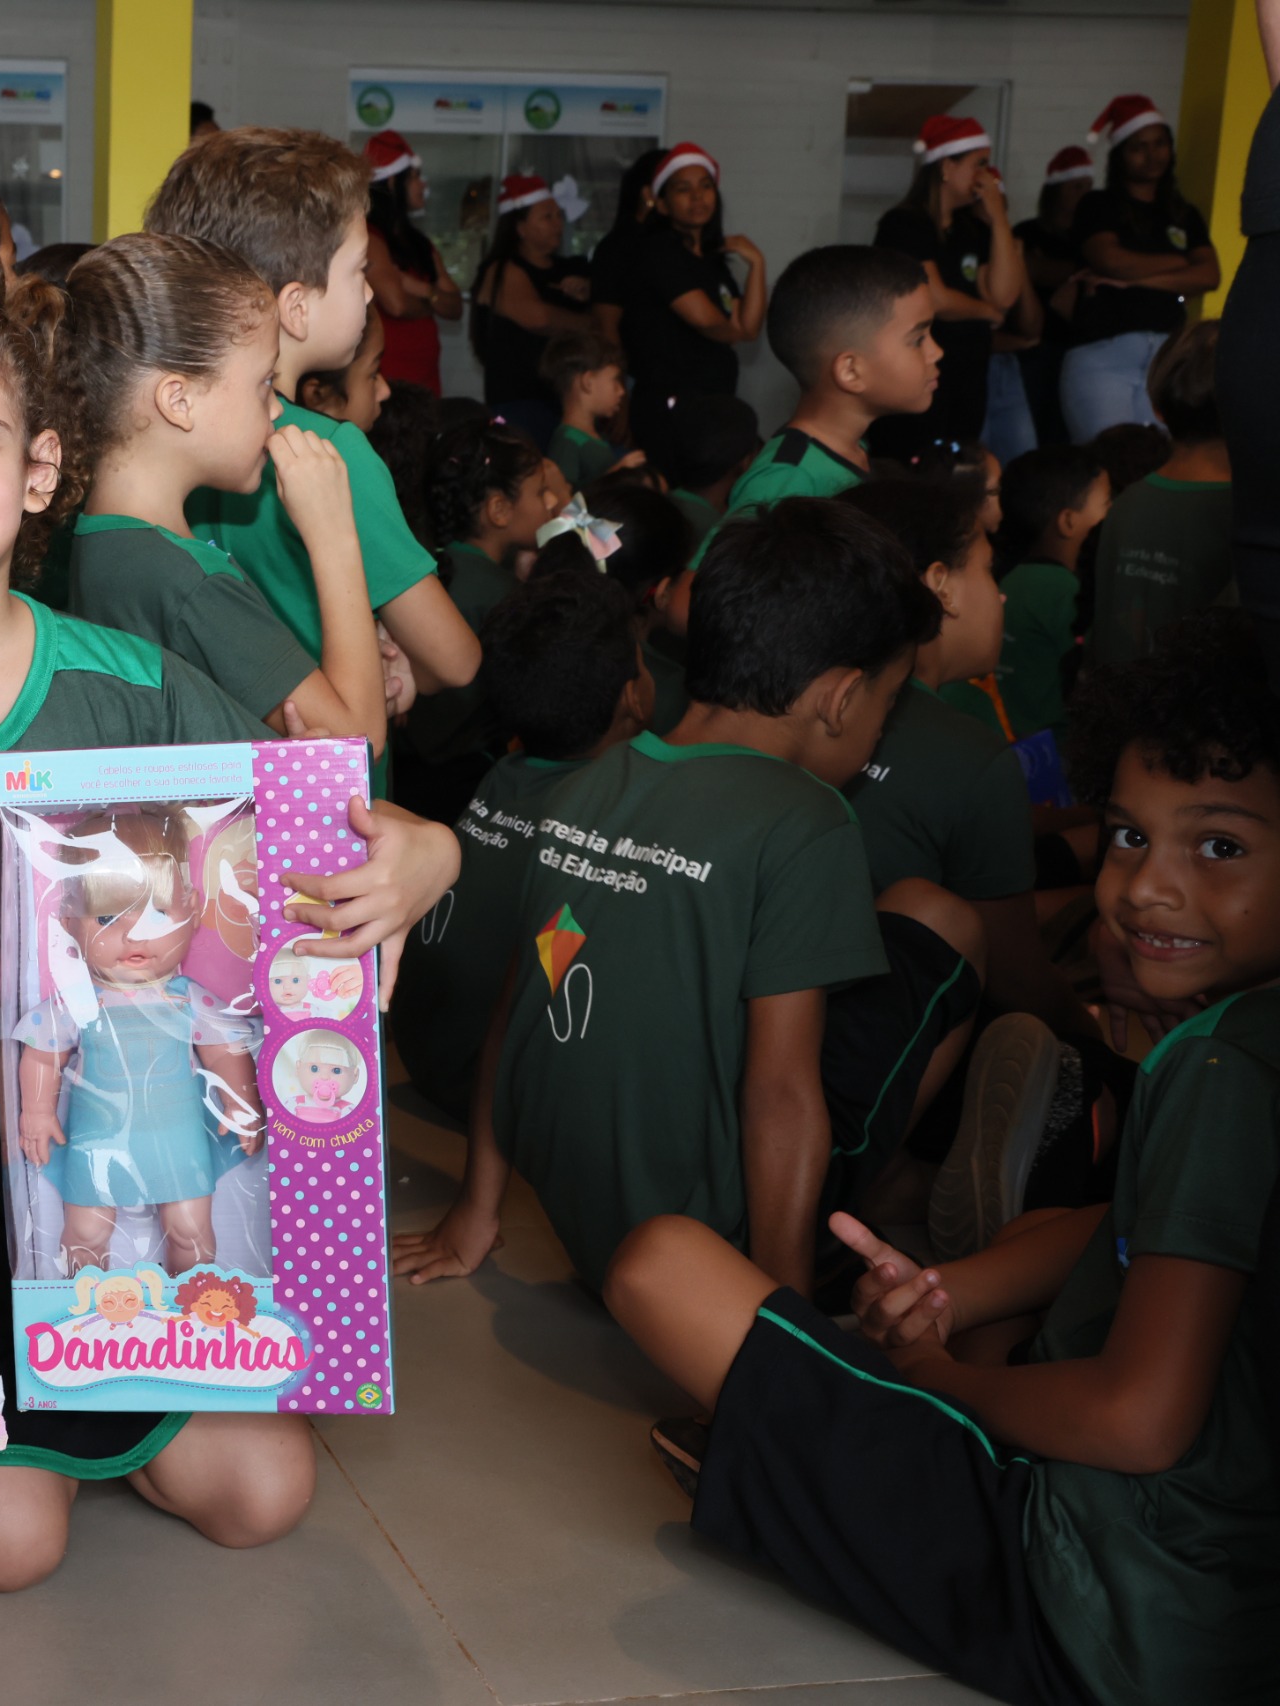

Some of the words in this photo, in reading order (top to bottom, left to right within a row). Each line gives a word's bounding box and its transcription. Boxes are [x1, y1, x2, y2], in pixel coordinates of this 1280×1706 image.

[80, 779, 101, 789] você
[103, 777, 141, 788] escolher
[145, 779, 151, 787] a
[154, 778, 170, 786] sua
[173, 776, 206, 785] boneca
[209, 774, 242, 784] favorita
[98, 765, 133, 775] Cabelos
[135, 766, 141, 774] e
[144, 764, 175, 774] roupas
[178, 762, 218, 772] estilosas
[222, 761, 241, 771] para
[539, 847, 562, 869] da
[561, 853, 648, 895] Educação
[612, 836, 712, 883] Municipal
[272, 1119, 296, 1141] vem
[299, 1135, 326, 1148] com
[330, 1118, 375, 1148] chupeta
[24, 1320, 315, 1372] Danadinhas
[38, 1400, 57, 1408] ANOS
